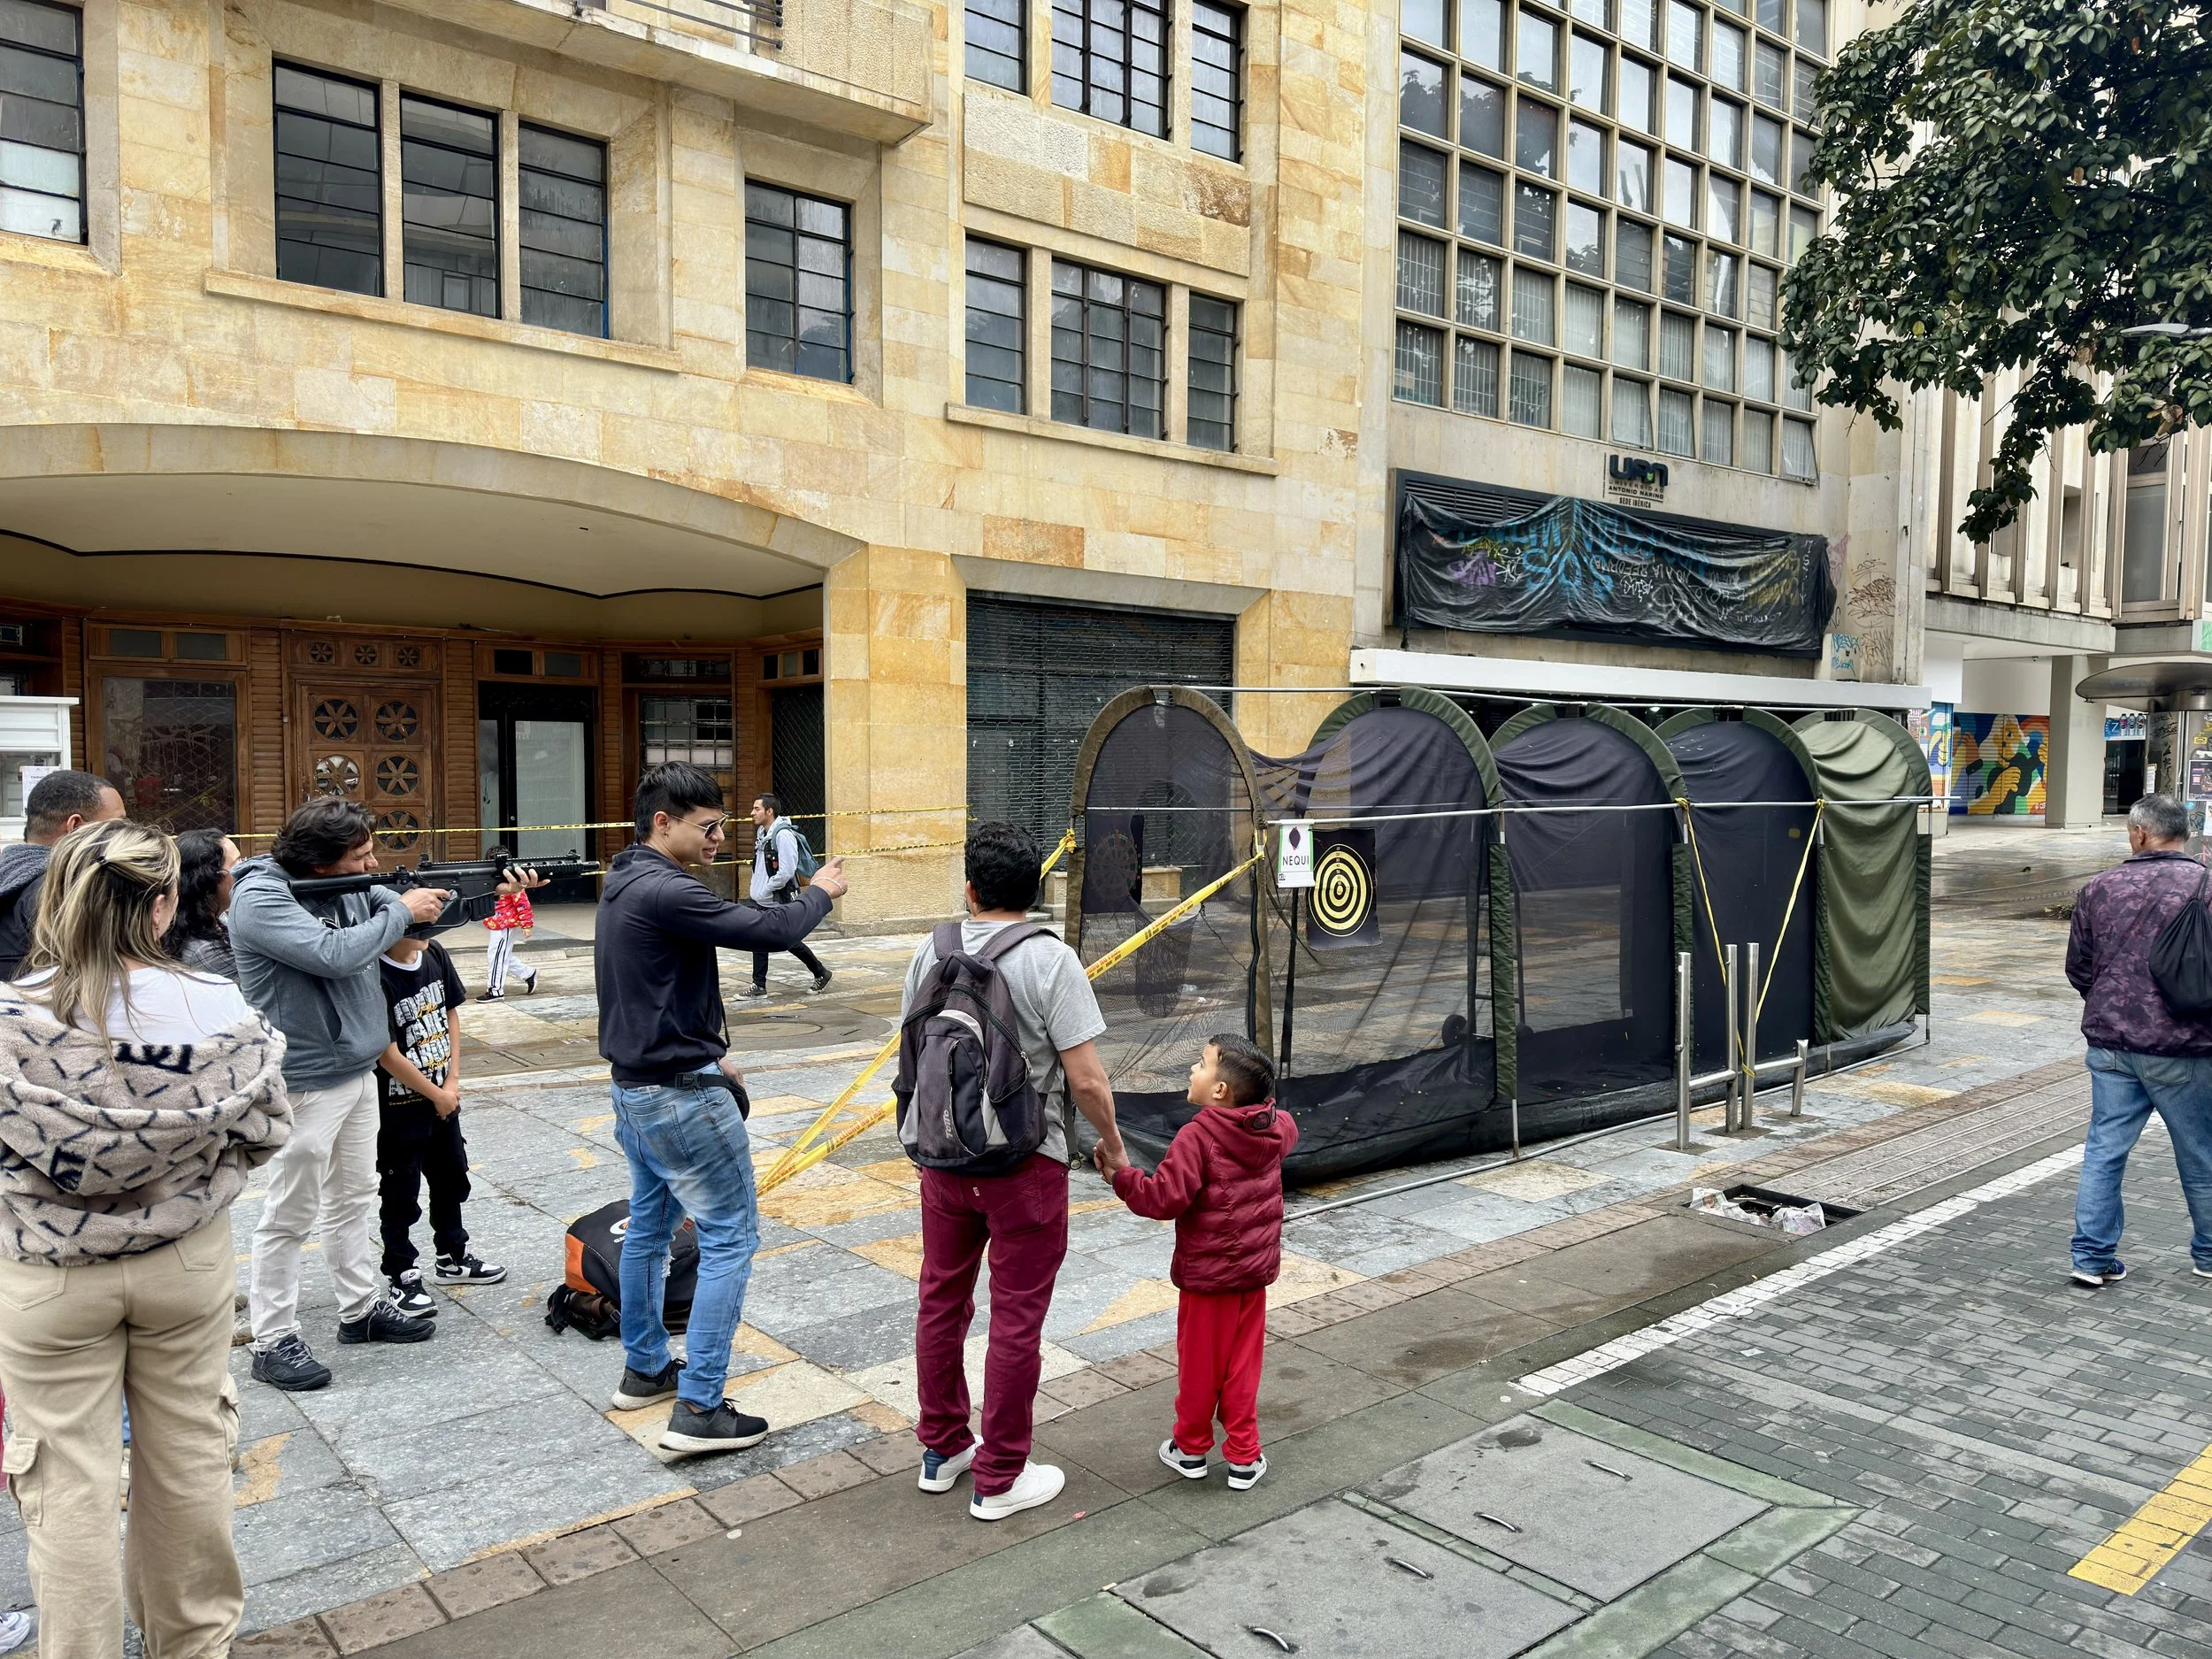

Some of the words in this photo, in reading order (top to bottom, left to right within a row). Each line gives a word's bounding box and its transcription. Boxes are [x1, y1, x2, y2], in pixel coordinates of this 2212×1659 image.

[1609, 485, 1637, 494] ANTONIO
[1619, 496, 1632, 505] SEDE
[1282, 855, 1310, 865] NEQUI
[943, 1109, 953, 1139] TOTTO
